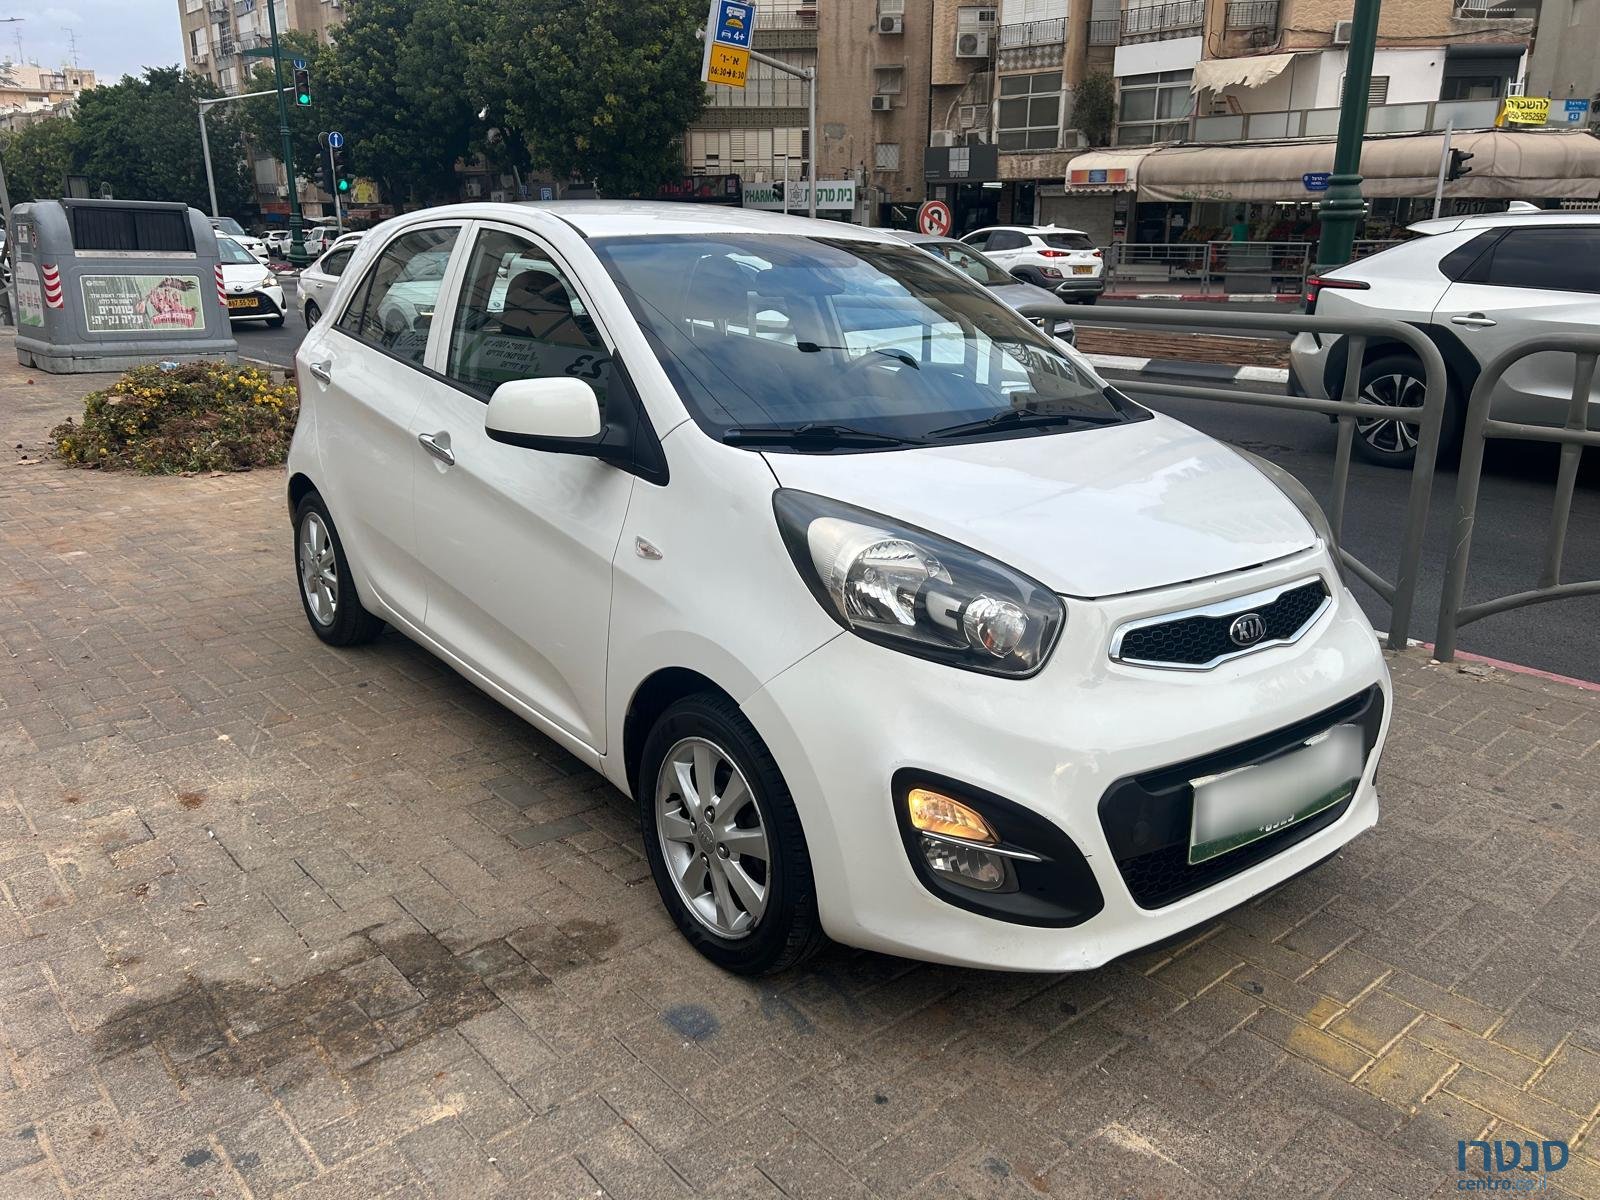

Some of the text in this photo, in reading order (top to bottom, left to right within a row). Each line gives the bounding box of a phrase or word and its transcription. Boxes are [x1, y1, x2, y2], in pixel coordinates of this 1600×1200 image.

[733, 31, 745, 40] 4+
[1507, 99, 1549, 110] להשכרה
[805, 188, 853, 206] בית מרקת
[98, 305, 134, 314] שומרים
[91, 315, 119, 326] נקייה!
[121, 314, 144, 324] עליה
[1236, 618, 1264, 641] KIA
